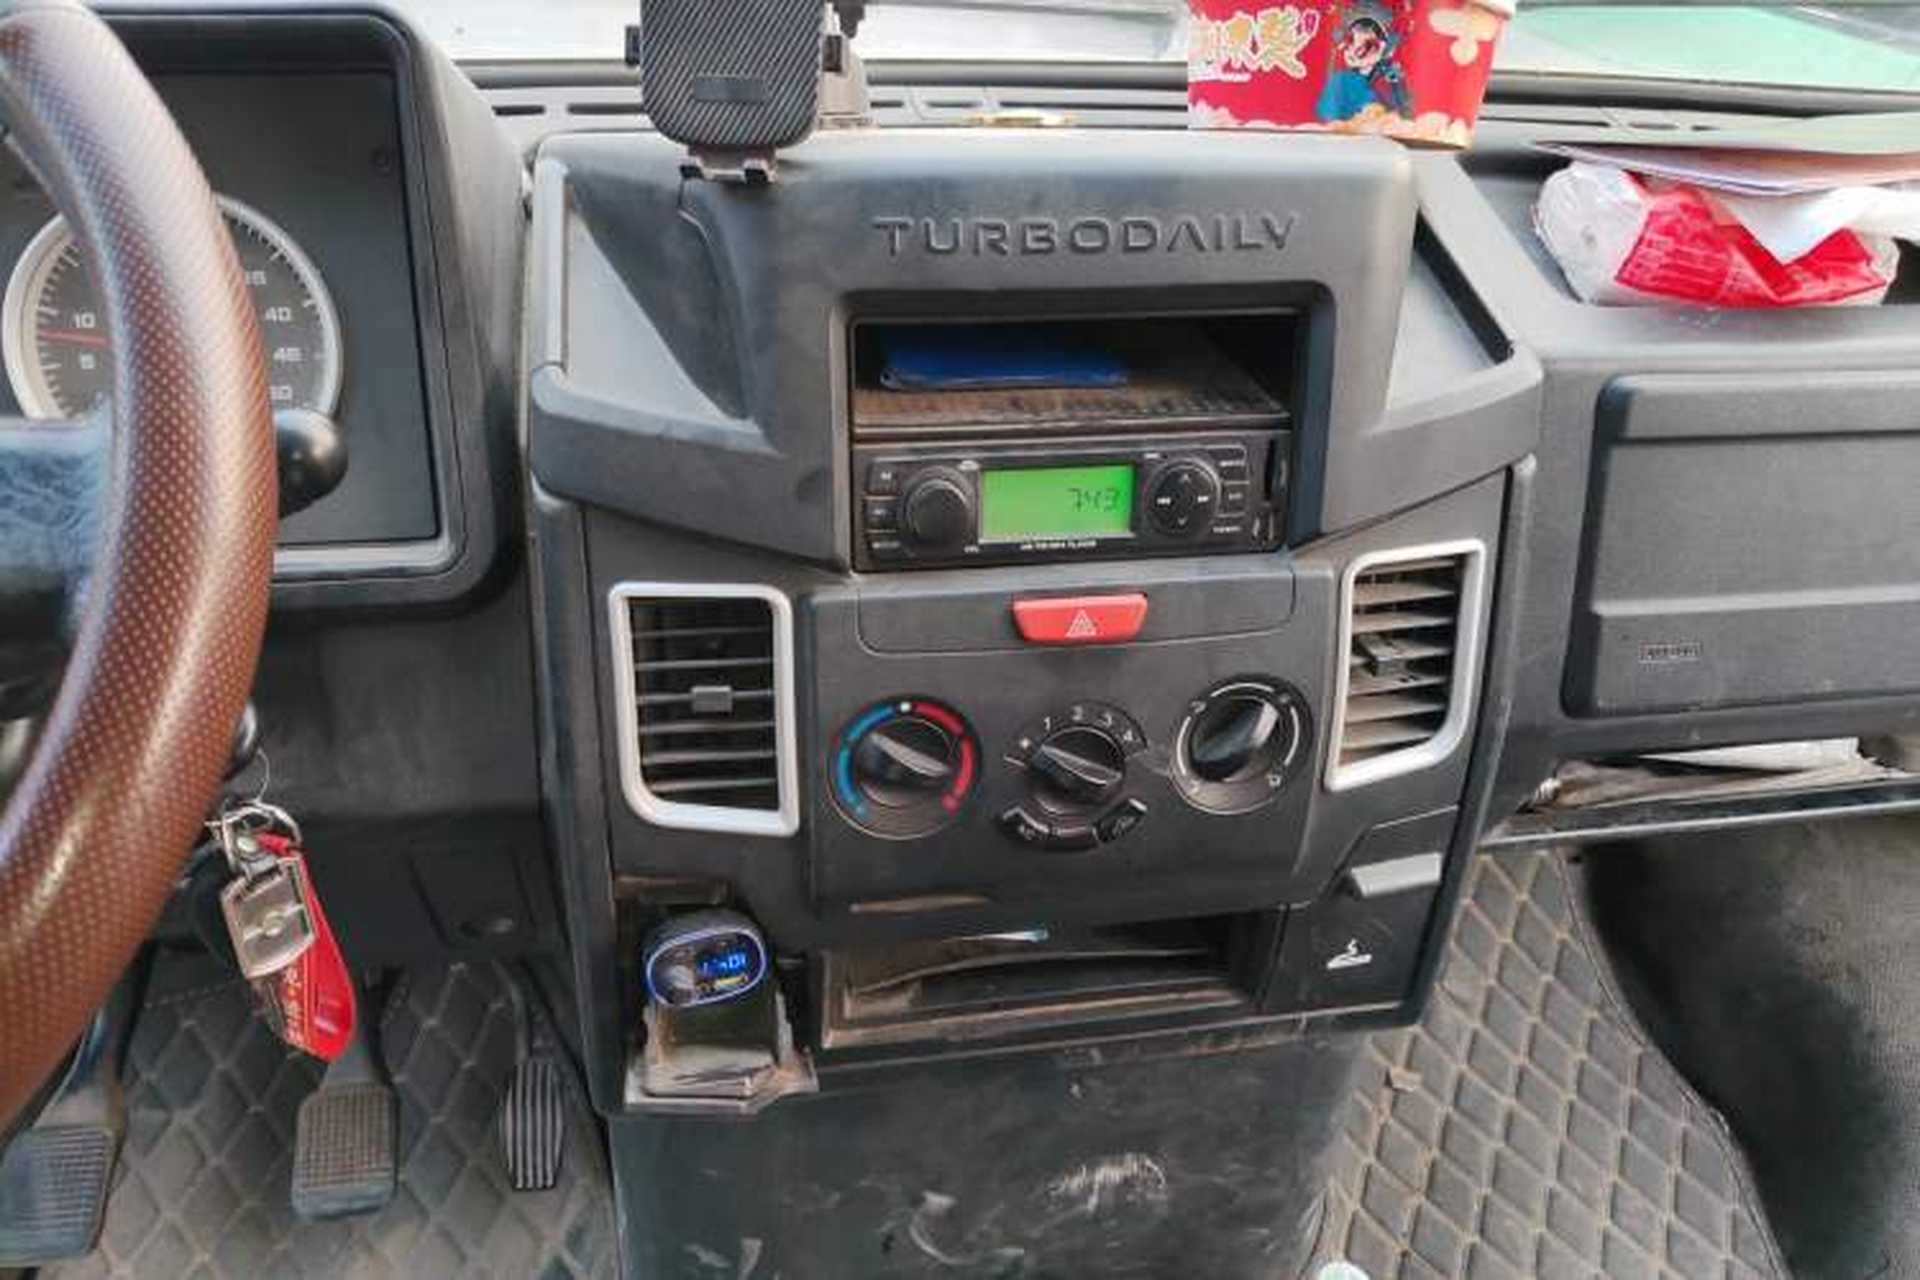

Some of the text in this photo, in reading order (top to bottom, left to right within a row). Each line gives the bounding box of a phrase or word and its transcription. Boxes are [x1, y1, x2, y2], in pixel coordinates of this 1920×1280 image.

[873, 214, 1298, 255] TURBODAILY
[73, 312, 96, 328] 10
[265, 306, 291, 322] 40
[1043, 716, 1051, 731] 1
